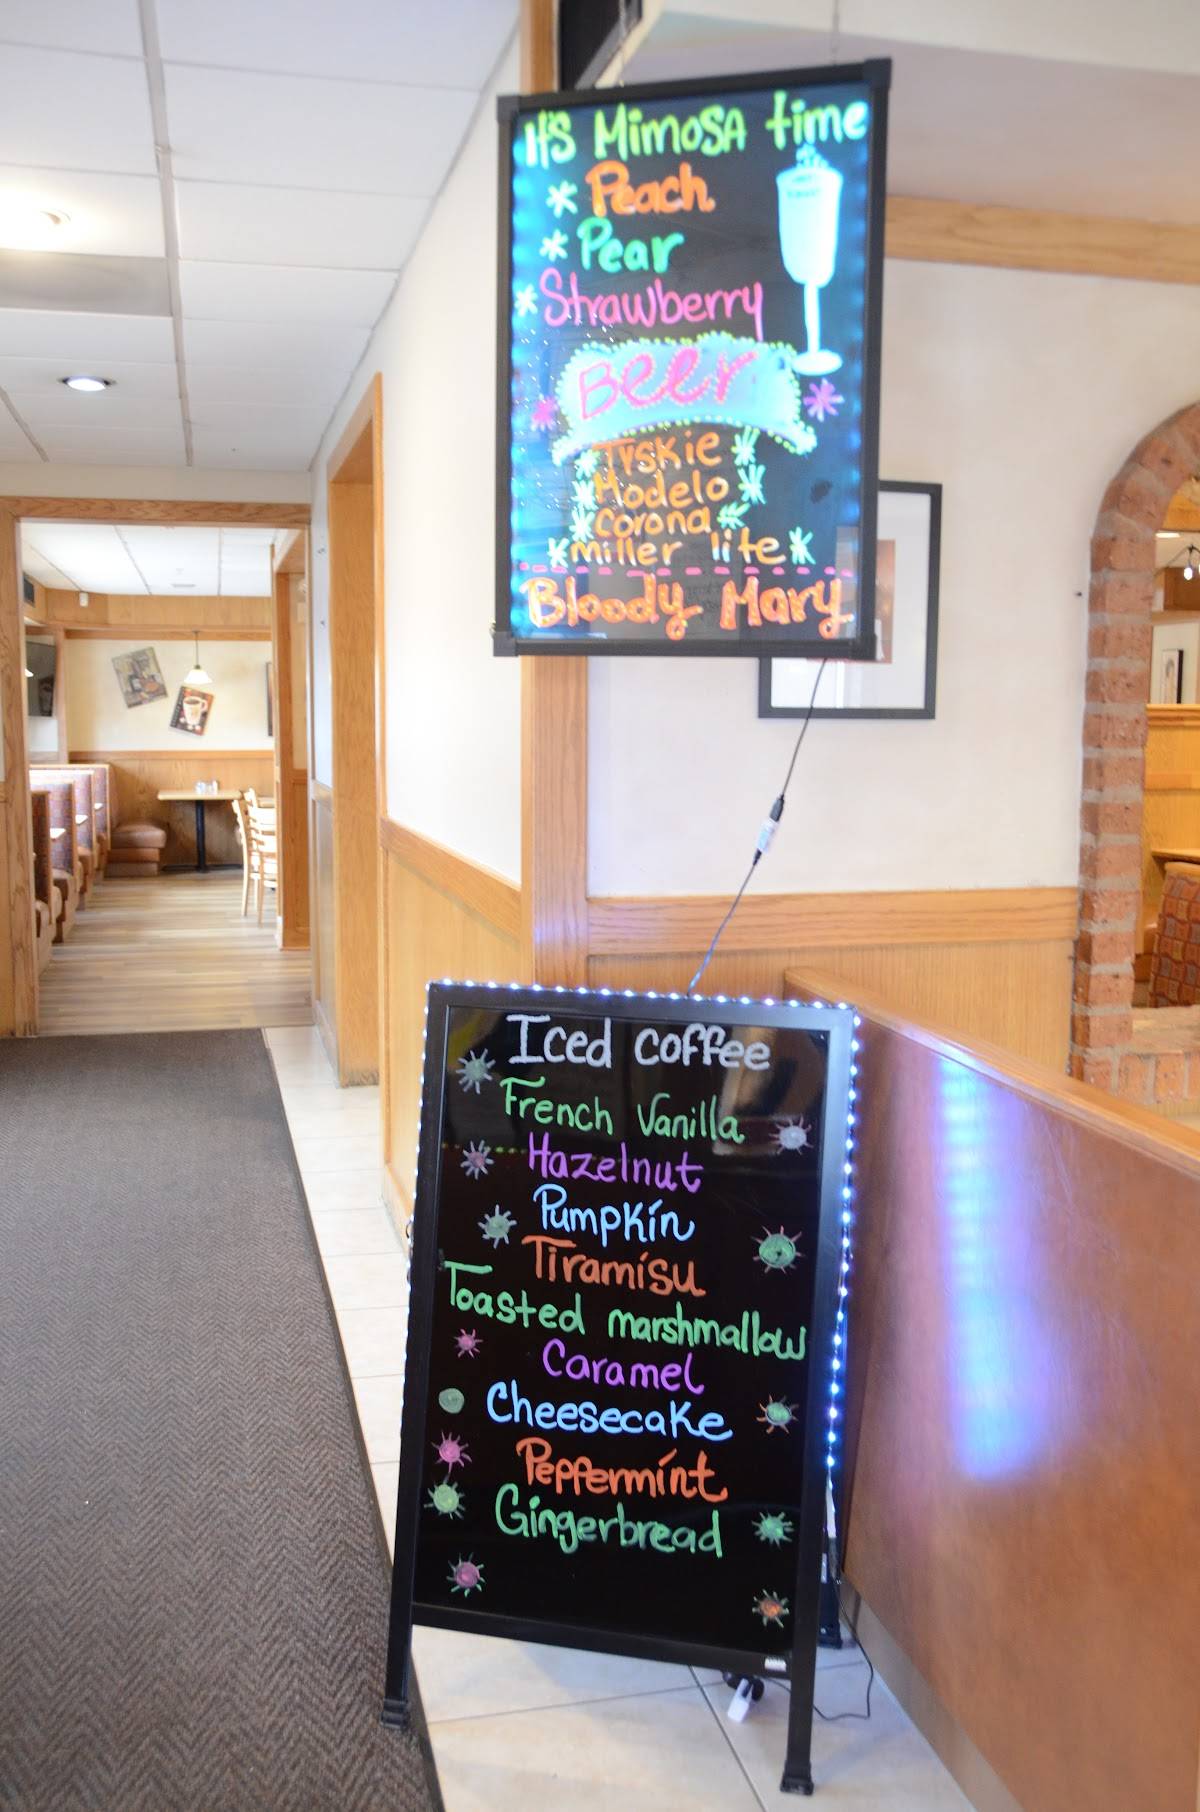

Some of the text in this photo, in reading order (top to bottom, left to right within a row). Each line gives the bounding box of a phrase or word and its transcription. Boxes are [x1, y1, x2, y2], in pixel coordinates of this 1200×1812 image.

[765, 90, 869, 150] time
[586, 160, 716, 217] Peach
[576, 217, 684, 273] Pear
[540, 267, 764, 342] Strawberry
[577, 347, 758, 420] Beer
[592, 469, 729, 510] Modelo
[711, 526, 787, 566] lite
[520, 573, 855, 640] Bloody Mary
[506, 1013, 611, 1068] Iced
[500, 1076, 745, 1143] French Vanilla
[528, 1132, 704, 1193] Hazelnut
[533, 1183, 696, 1247] Pumpkin
[521, 1234, 706, 1297] Tiramisu
[443, 1260, 807, 1361] Toasted marshmallow
[542, 1338, 705, 1395] Caramel
[486, 1380, 733, 1441] Cheesecake
[515, 1437, 729, 1502] Peppermint
[495, 1482, 724, 1559] Gingerbread
